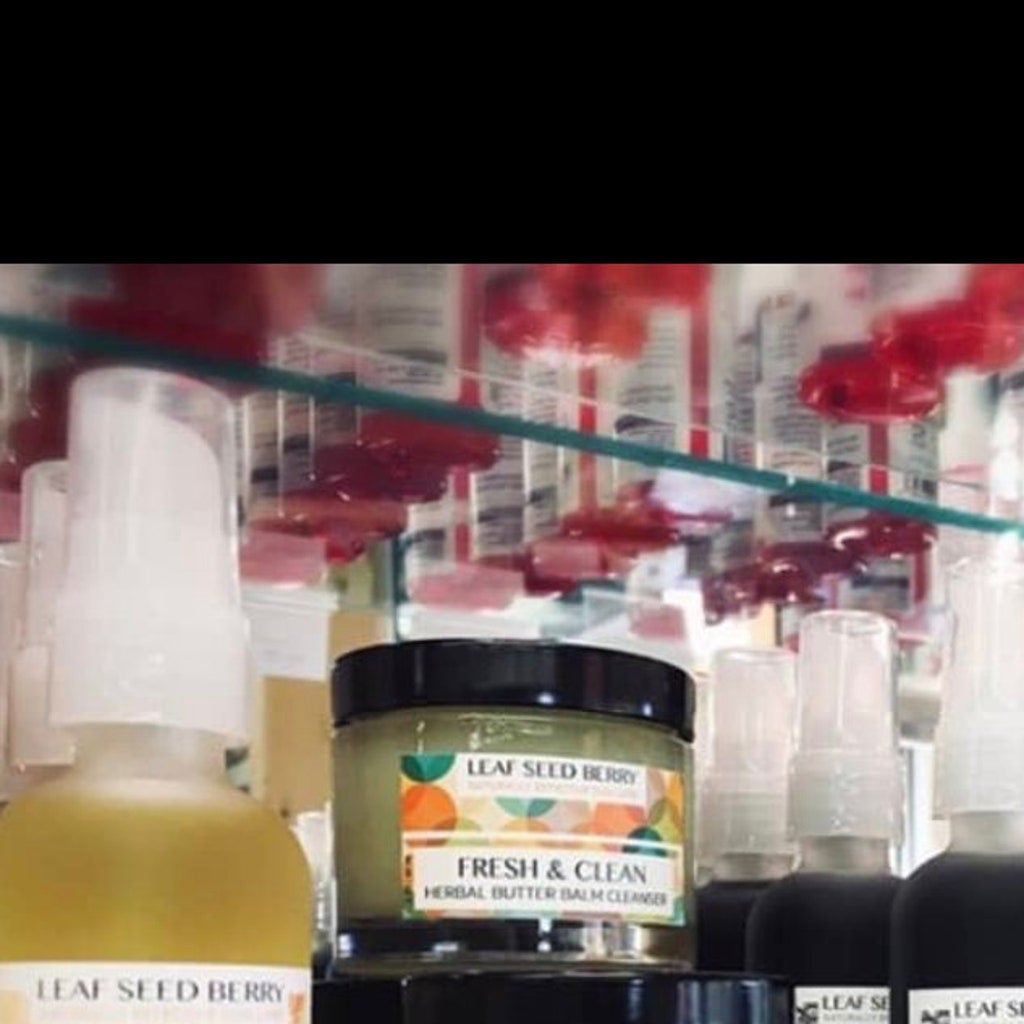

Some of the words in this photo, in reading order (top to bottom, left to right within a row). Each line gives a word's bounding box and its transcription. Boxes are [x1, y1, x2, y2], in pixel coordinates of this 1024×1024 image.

[466, 759, 517, 777] LEAF
[523, 762, 577, 780] SEED
[582, 767, 637, 785] BERRY
[457, 857, 538, 879] FRESH
[546, 859, 566, 881] &
[574, 861, 647, 884] CLEAN
[424, 884, 485, 900] HERBAL
[491, 885, 556, 901] BUTTER
[561, 887, 604, 903] BALM
[36, 978, 101, 1002] LEAF
[117, 978, 200, 1002] SEED
[208, 980, 284, 1004] BERRY
[822, 996, 863, 1012] LEAF
[954, 1000, 1002, 1019] LEAF
